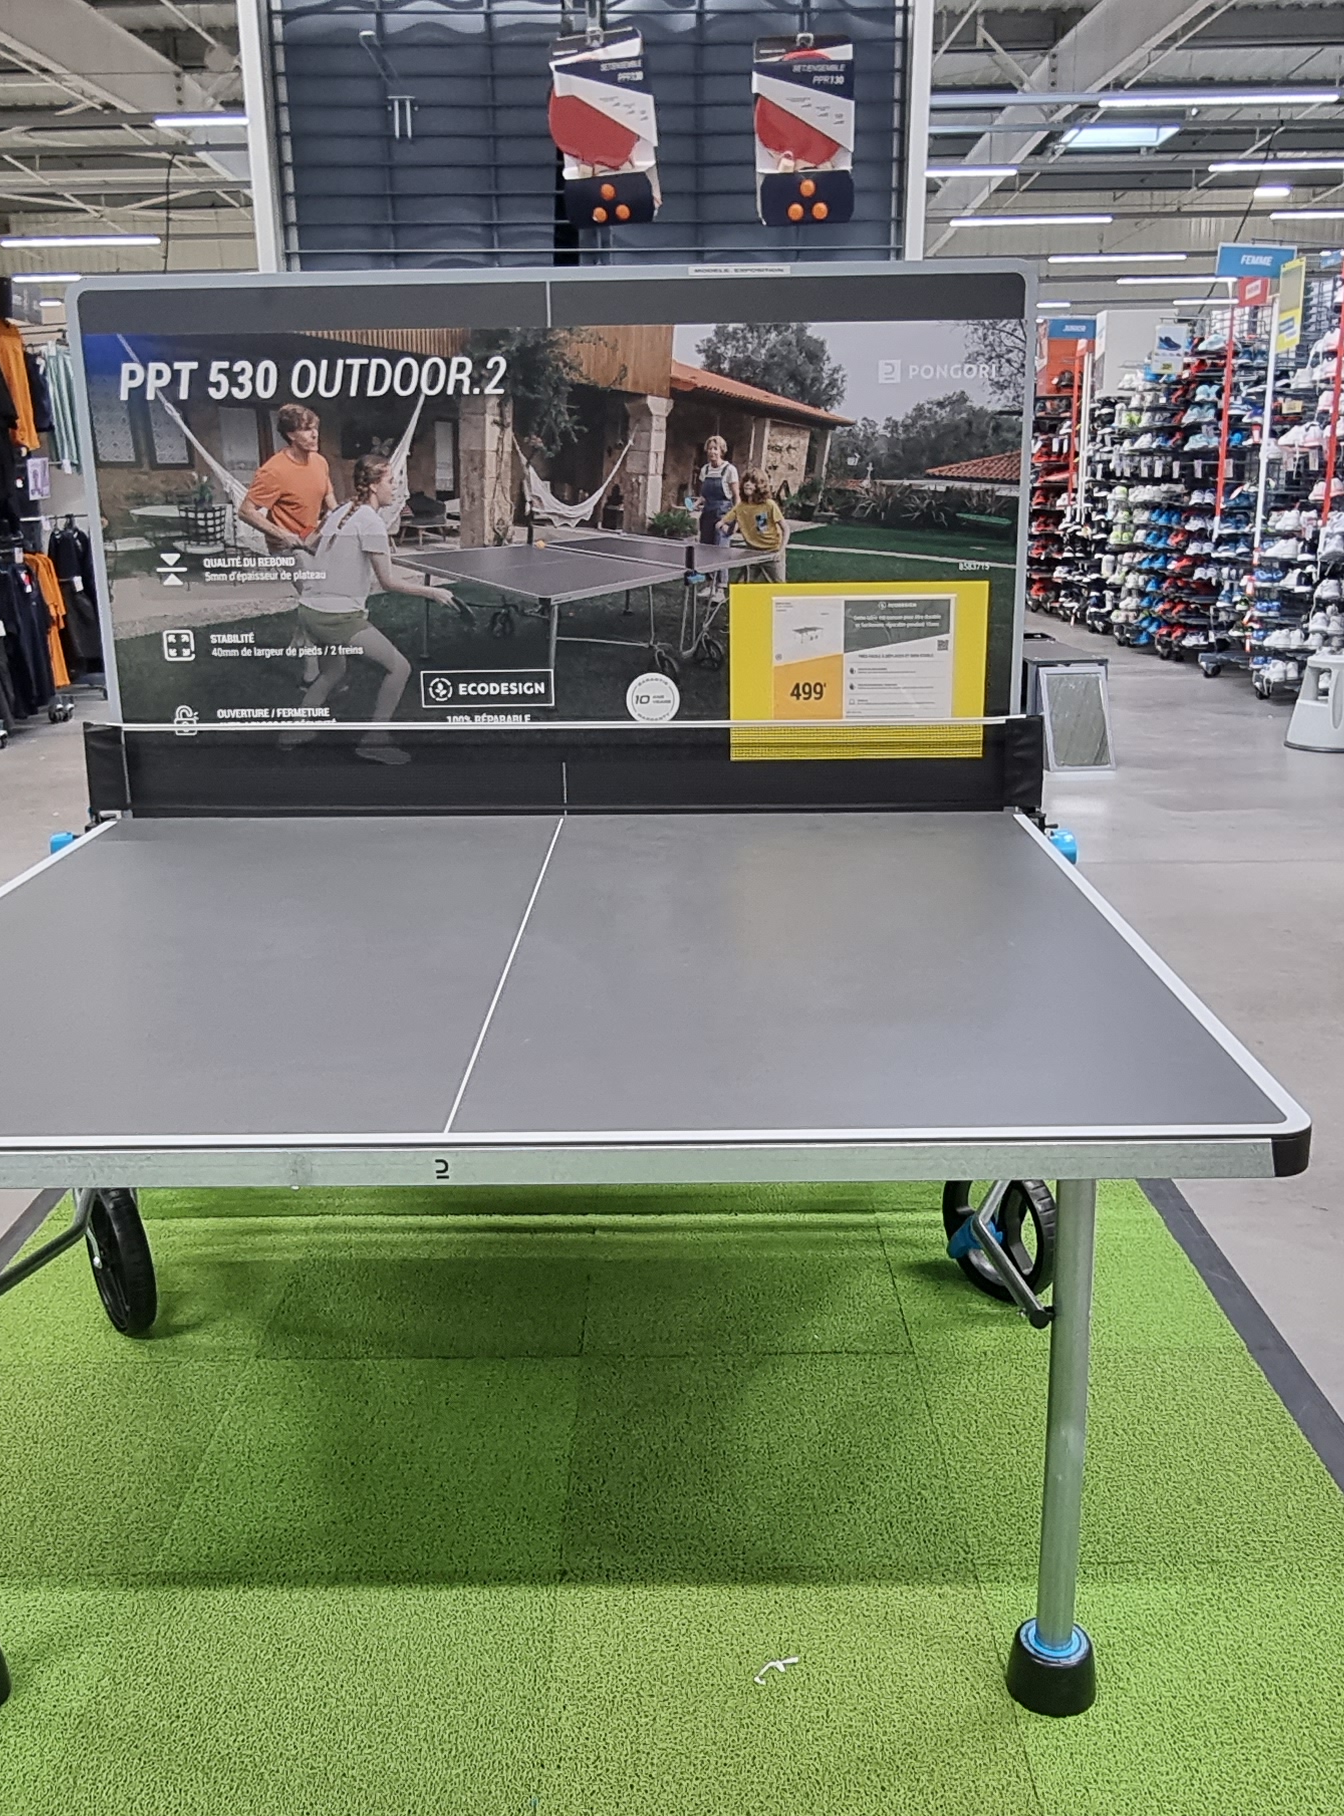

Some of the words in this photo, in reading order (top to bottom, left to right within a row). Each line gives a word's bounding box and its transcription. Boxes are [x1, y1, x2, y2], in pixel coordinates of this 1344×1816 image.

[1240, 254, 1273, 267] FEMME
[908, 363, 996, 380] PONGORI
[119, 360, 199, 401] PPT
[207, 359, 279, 400] 530
[290, 355, 508, 399] OUTDOOR.2
[203, 556, 242, 568] QUALITÉ
[243, 557, 256, 567] DU
[257, 557, 295, 568] REBOND
[204, 571, 228, 582] 5mm
[281, 570, 292, 580] de
[294, 570, 326, 582] plateau
[210, 632, 254, 644] STABILITÉ
[211, 648, 240, 657] 40mm
[240, 647, 252, 656] de
[254, 646, 284, 659] largeur
[285, 646, 297, 656] de
[298, 646, 322, 658] pieds
[330, 646, 336, 655] 2
[338, 646, 364, 655] freins
[458, 682, 546, 696] ECODESIGN
[635, 694, 650, 704] 10
[216, 708, 270, 718] OUVERTURE
[276, 708, 330, 718] FERMETURE
